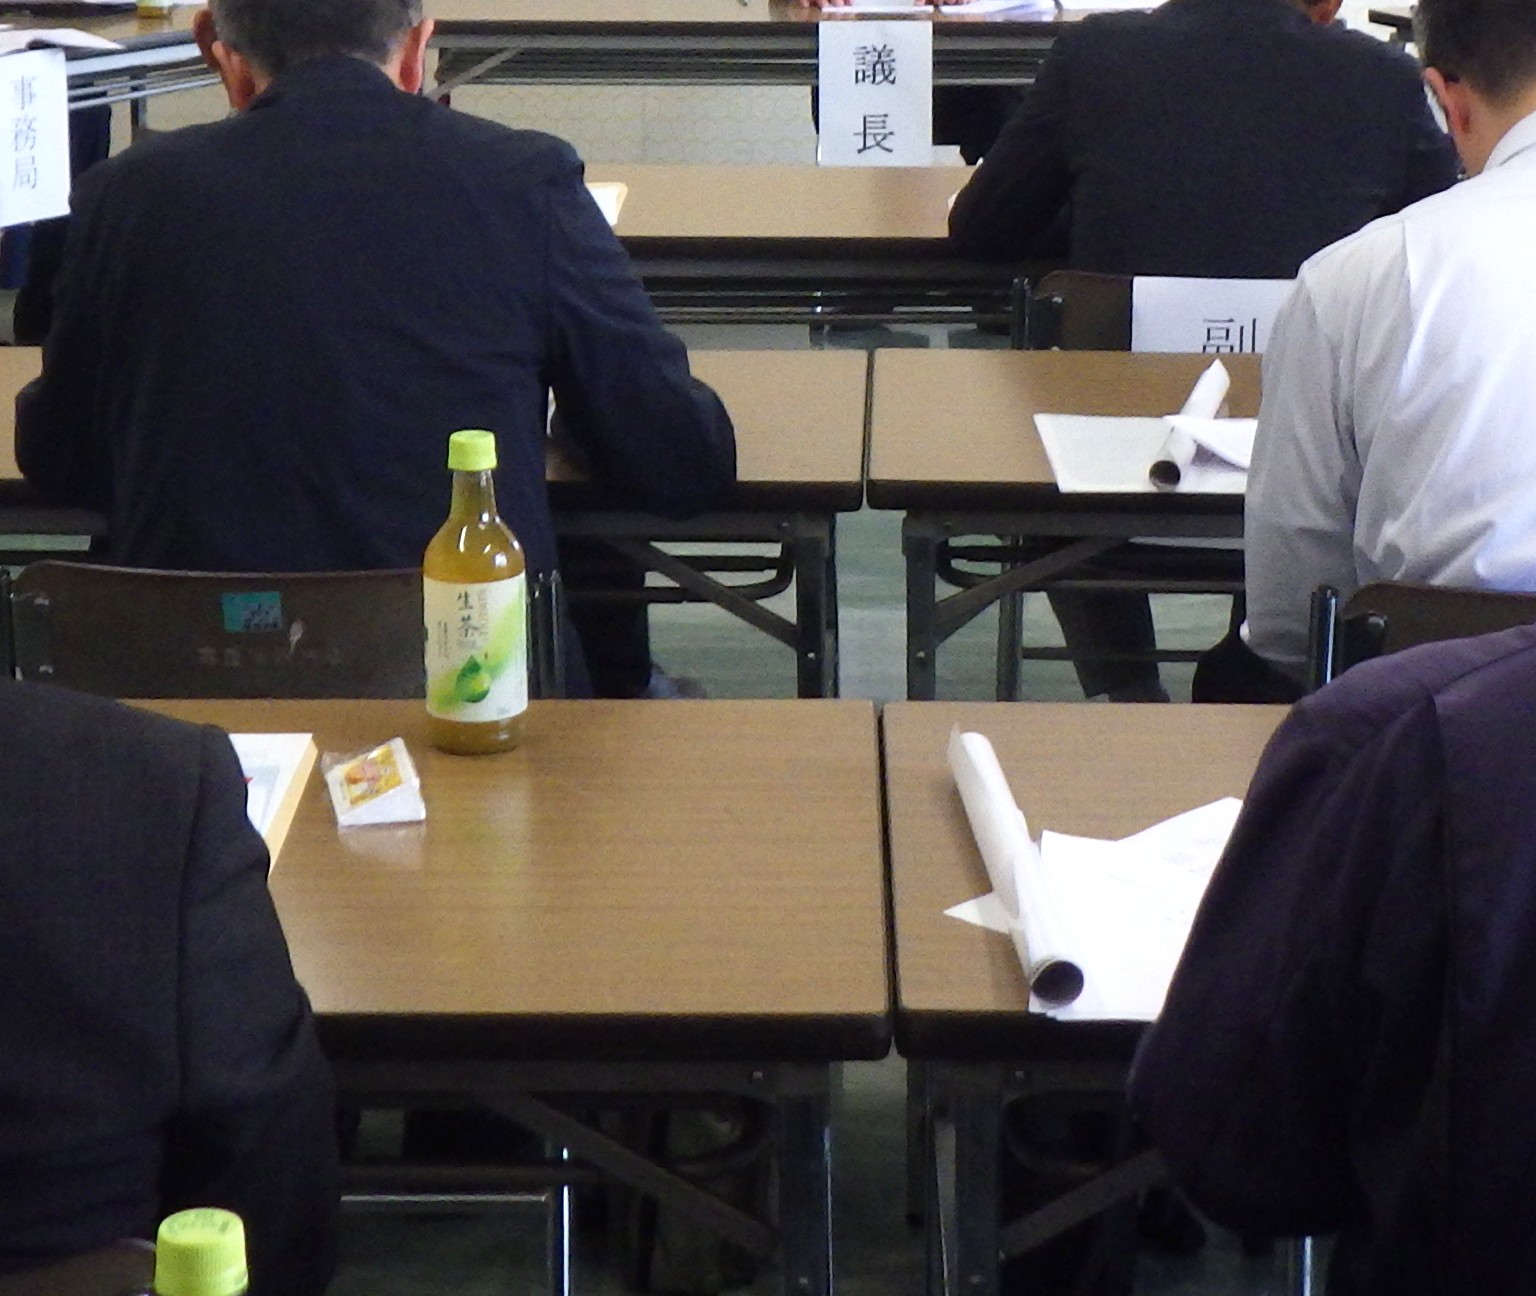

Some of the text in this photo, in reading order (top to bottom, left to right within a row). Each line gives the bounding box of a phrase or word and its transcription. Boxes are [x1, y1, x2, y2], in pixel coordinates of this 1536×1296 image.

[11, 74, 37, 189] 事務局
[853, 43, 896, 154] 議長
